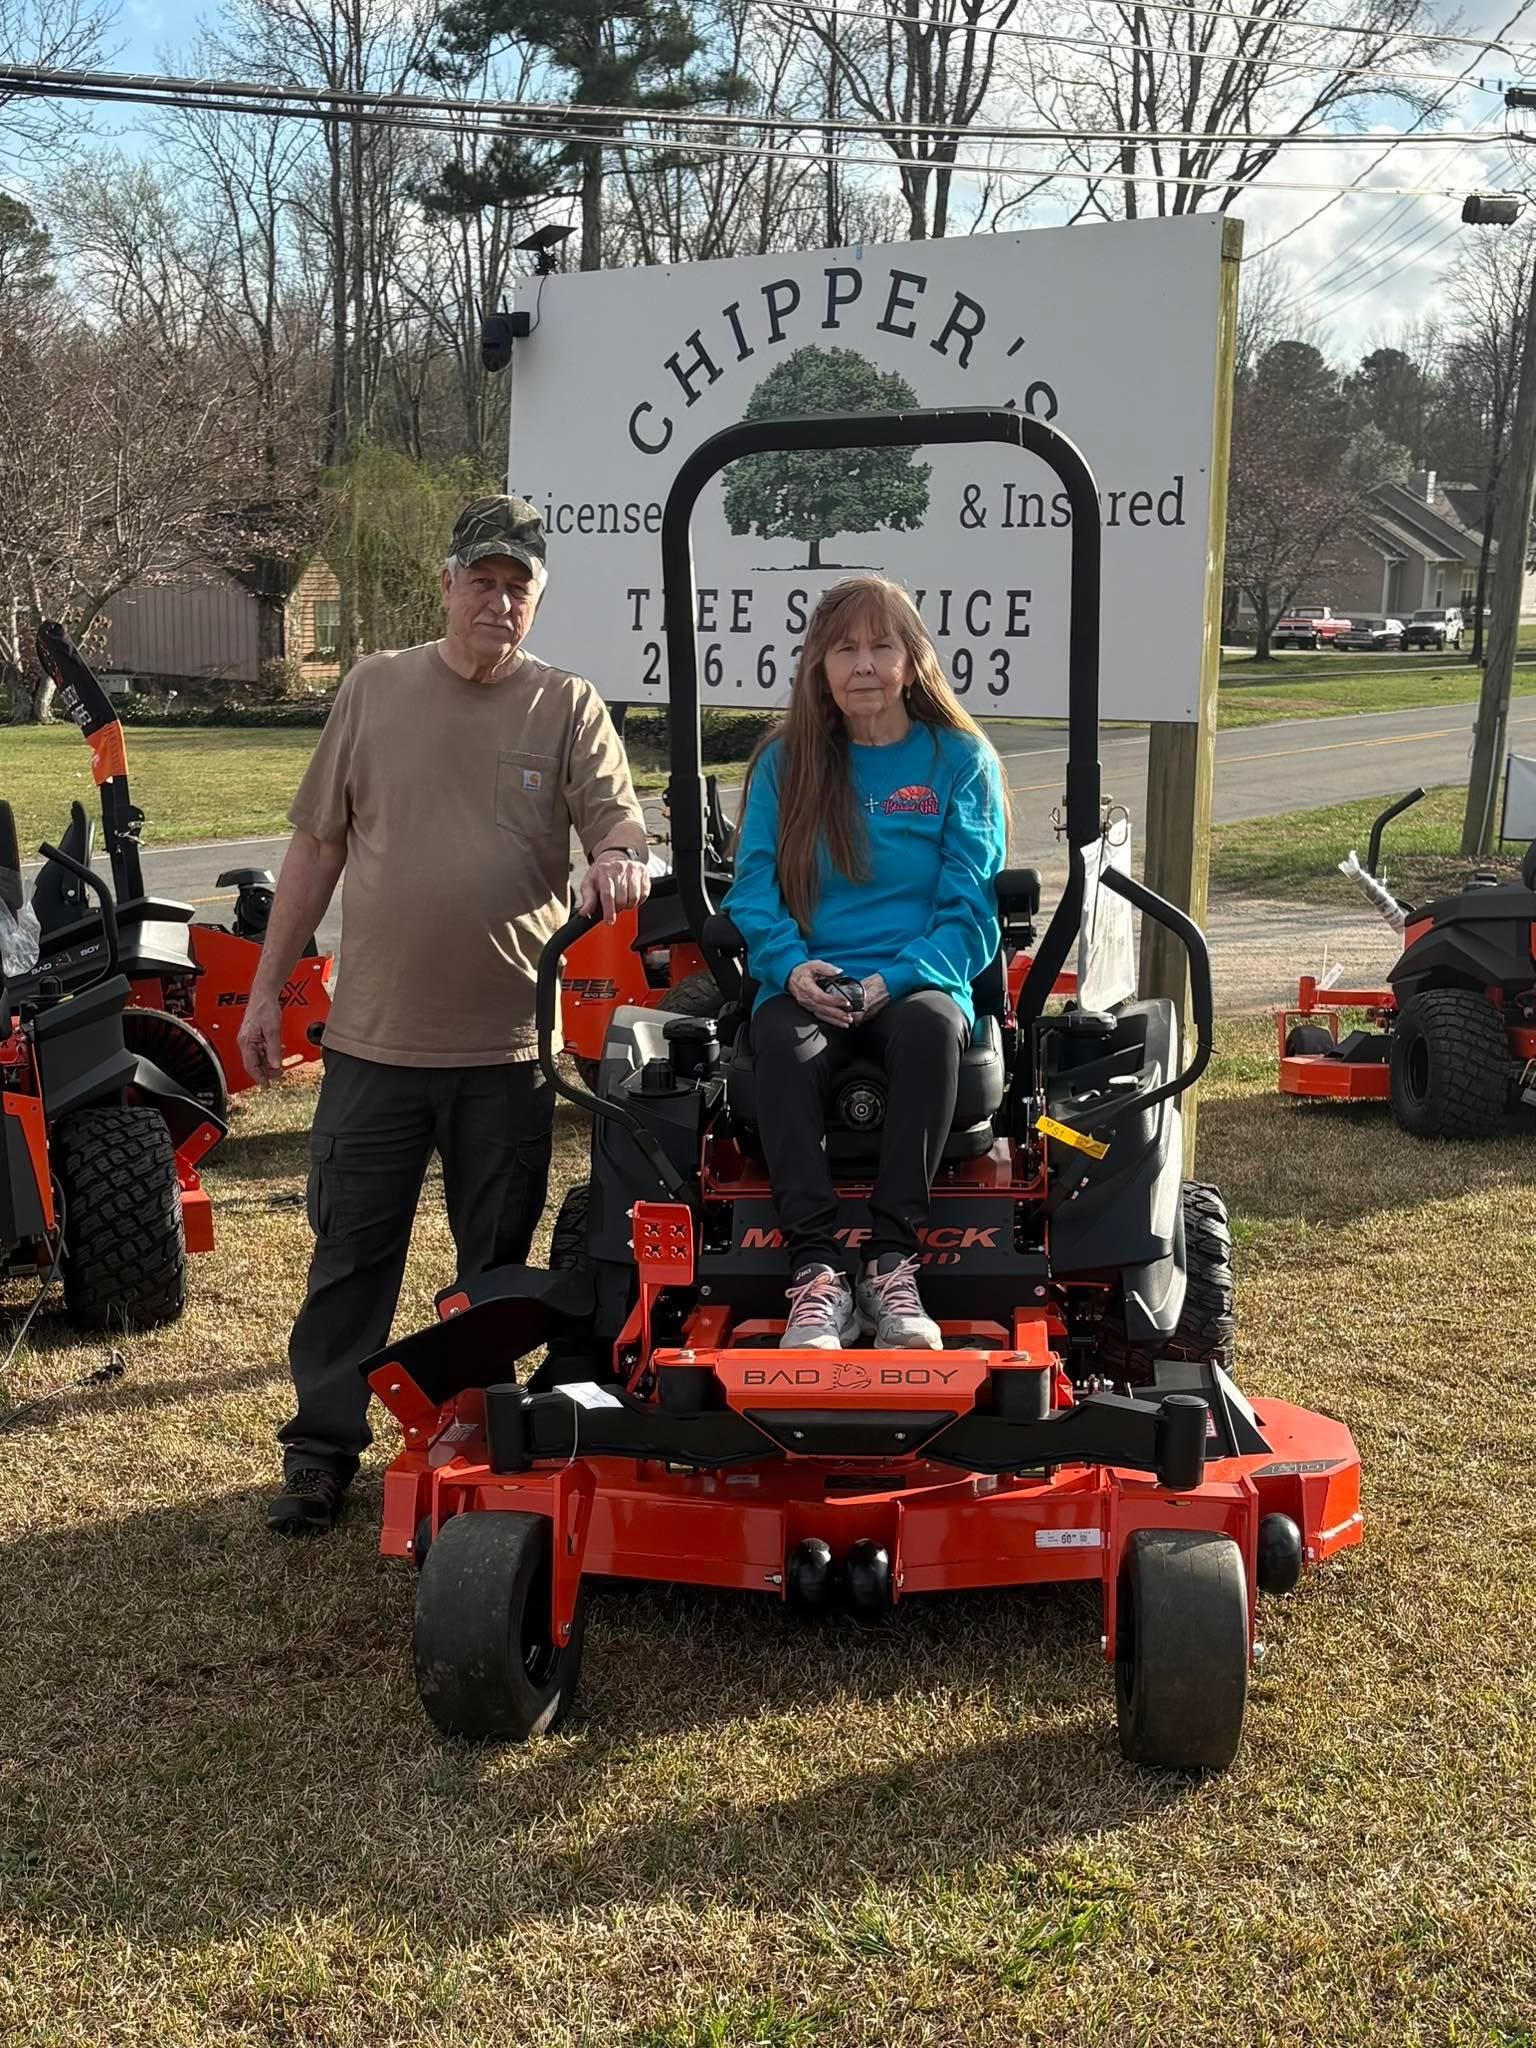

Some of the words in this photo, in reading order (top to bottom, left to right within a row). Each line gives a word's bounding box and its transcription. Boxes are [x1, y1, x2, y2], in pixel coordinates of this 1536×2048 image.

[522, 491, 663, 534] icense
[959, 483, 987, 529] &
[1001, 475, 1186, 528] Insred
[785, 588, 1032, 637] SICE
[31, 962, 52, 975] BAD
[80, 943, 100, 956] BOY
[560, 978, 620, 993] EBEL
[743, 1369, 820, 1385] BAD
[880, 1368, 959, 1385] BOY
